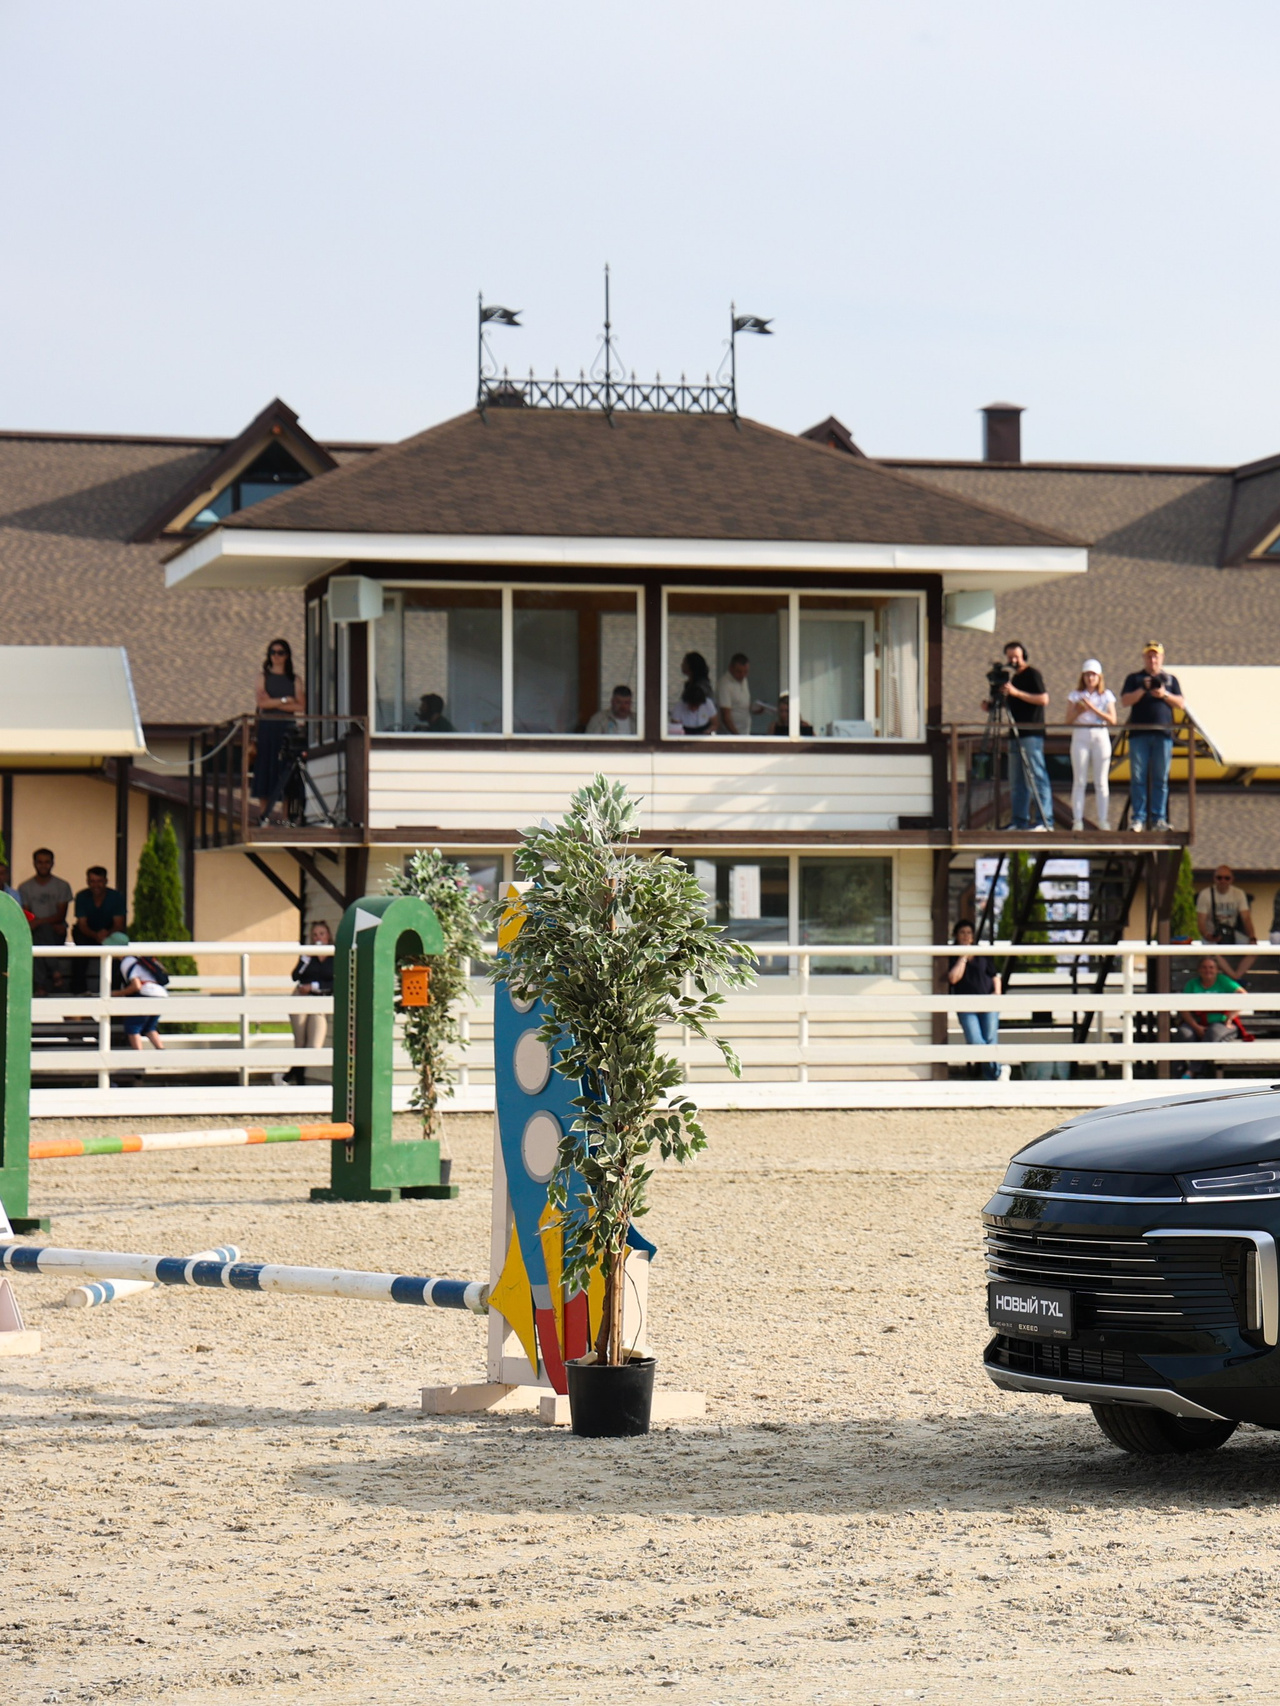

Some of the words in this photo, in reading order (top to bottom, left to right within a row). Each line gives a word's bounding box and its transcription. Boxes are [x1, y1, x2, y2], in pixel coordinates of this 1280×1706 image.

[995, 1295, 1038, 1314] НОВЫЙ
[1040, 1300, 1063, 1317] TXL
[1018, 1323, 1038, 1332] EXEED
